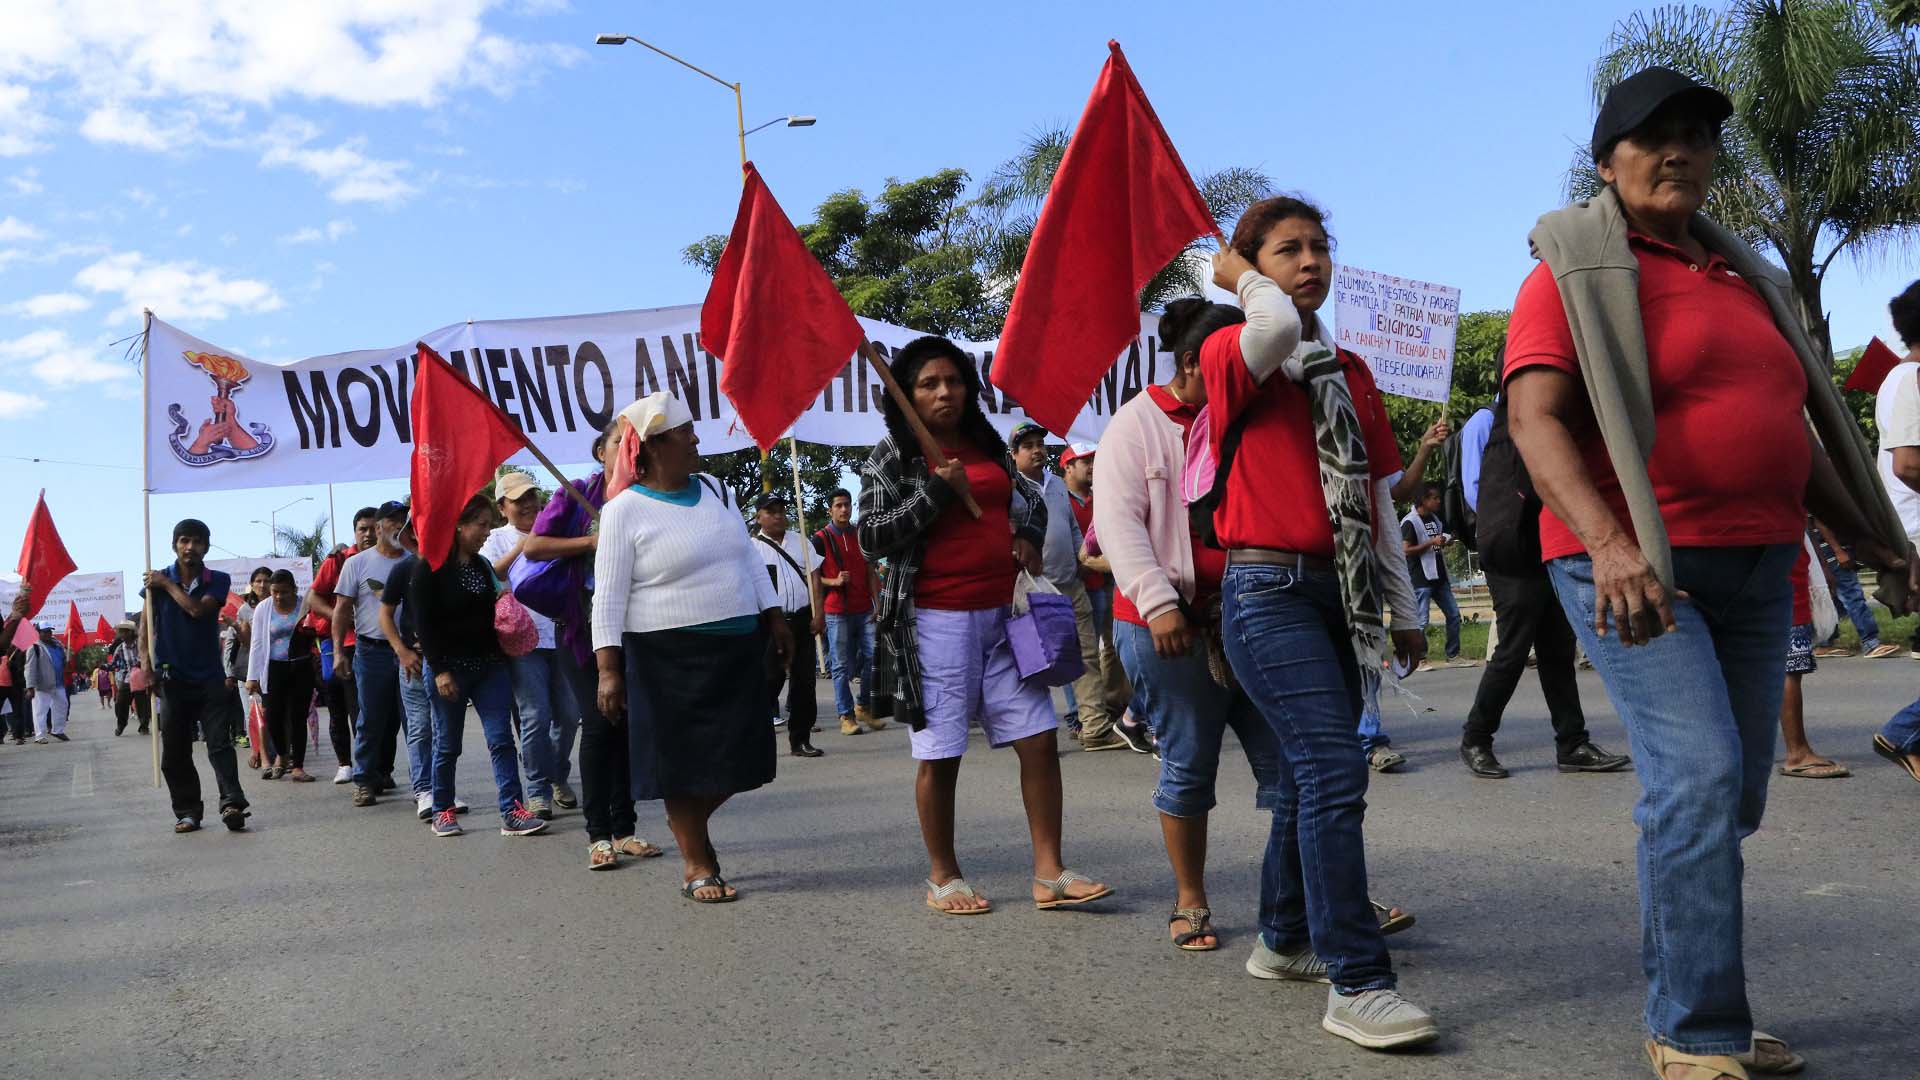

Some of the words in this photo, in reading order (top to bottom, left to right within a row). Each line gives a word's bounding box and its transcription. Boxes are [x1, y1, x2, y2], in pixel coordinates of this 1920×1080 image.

[1337, 290, 1347, 304] DE
[1350, 293, 1380, 310] FAMILIA
[1338, 273, 1377, 296] ALUMNOS,
[1378, 283, 1418, 304] MAESTROS
[1422, 294, 1427, 307] Y
[1430, 295, 1458, 313] PADRES
[1339, 327, 1351, 342] LA
[1385, 337, 1391, 352] Y
[1394, 340, 1430, 358] TECHADO
[1432, 347, 1447, 361] EN
